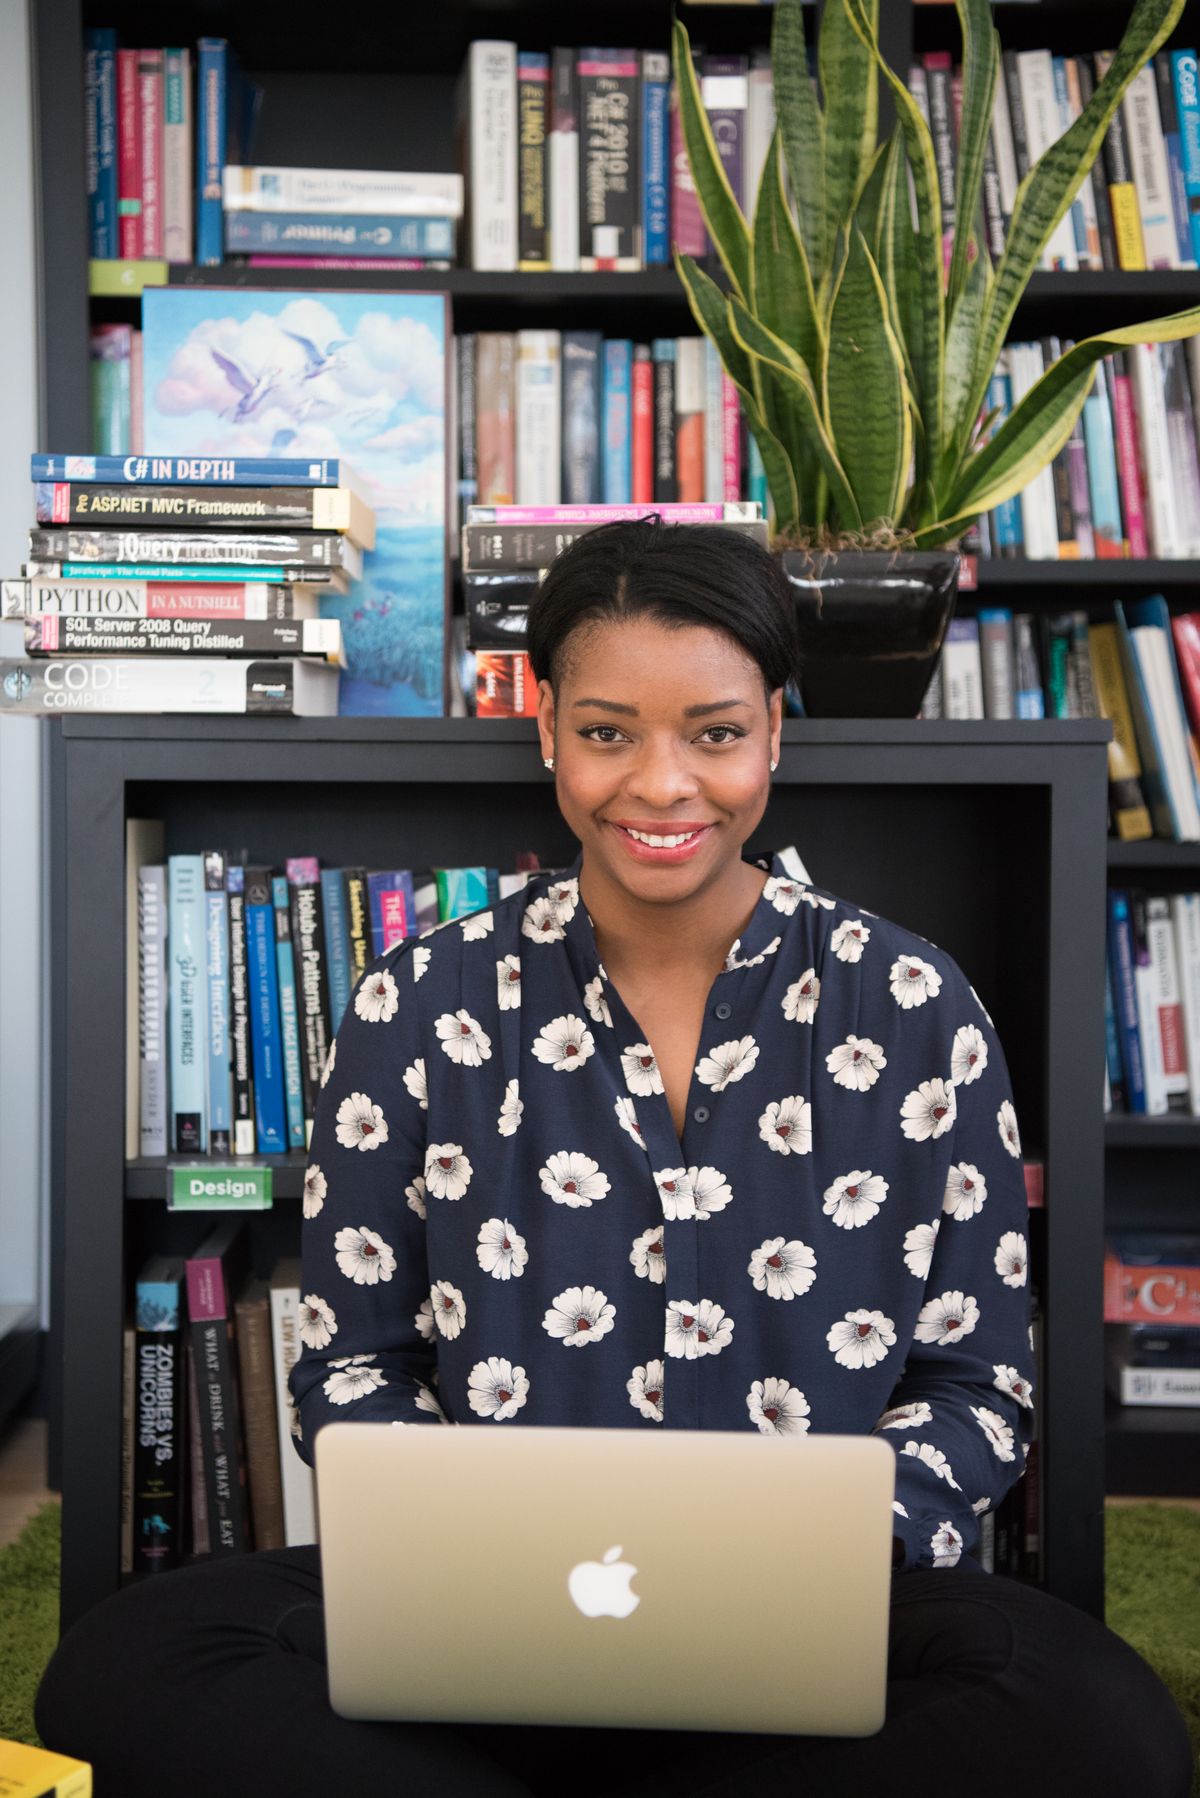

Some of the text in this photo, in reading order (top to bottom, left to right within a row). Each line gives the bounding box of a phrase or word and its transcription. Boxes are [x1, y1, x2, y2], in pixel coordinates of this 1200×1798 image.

[520, 99, 545, 145] LINQ
[607, 124, 629, 174] 2010
[123, 457, 235, 481] C# IN DEPTH
[90, 496, 149, 514] ASP.NET
[152, 498, 184, 514] MVC
[187, 499, 266, 517] Framework
[116, 533, 182, 563] jQuery
[117, 567, 133, 577] The
[135, 567, 160, 577] Good
[161, 568, 184, 578] Parts
[38, 588, 241, 613] PYTHON IN A NUTSHELL
[65, 618, 211, 637] SQL Server 2008 Query
[65, 633, 244, 650] Performance Tuning Distilled
[44, 663, 130, 690] CODE
[513, 656, 525, 713] UNLEASHED
[143, 882, 159, 936] PAPER
[230, 897, 243, 920] User
[349, 879, 367, 969] Sketching User
[386, 894, 403, 926] THE
[231, 921, 245, 963] Interface
[297, 889, 322, 1015] Holub on Patterns
[176, 953, 197, 978] 3D
[207, 897, 227, 1057] Designing Interfaces
[232, 965, 247, 998] Design
[143, 943, 160, 1062] PROTOTYPING
[235, 999, 247, 1014] for
[180, 1007, 195, 1067] INTERFACES
[234, 1016, 249, 1081] Programmers
[281, 985, 299, 1096] WEB PAGE DESIGN
[190, 1179, 257, 1198] Design
[280, 1315, 296, 1343] LEW
[204, 1328, 220, 1372] WHAT
[139, 1345, 156, 1449] UNICORNS
[155, 1343, 174, 1430] ZOMBIES
[208, 1383, 224, 1432] DRINK
[154, 1434, 174, 1467] VS.
[215, 1455, 231, 1499] WHAT
[219, 1519, 235, 1549] EAT
